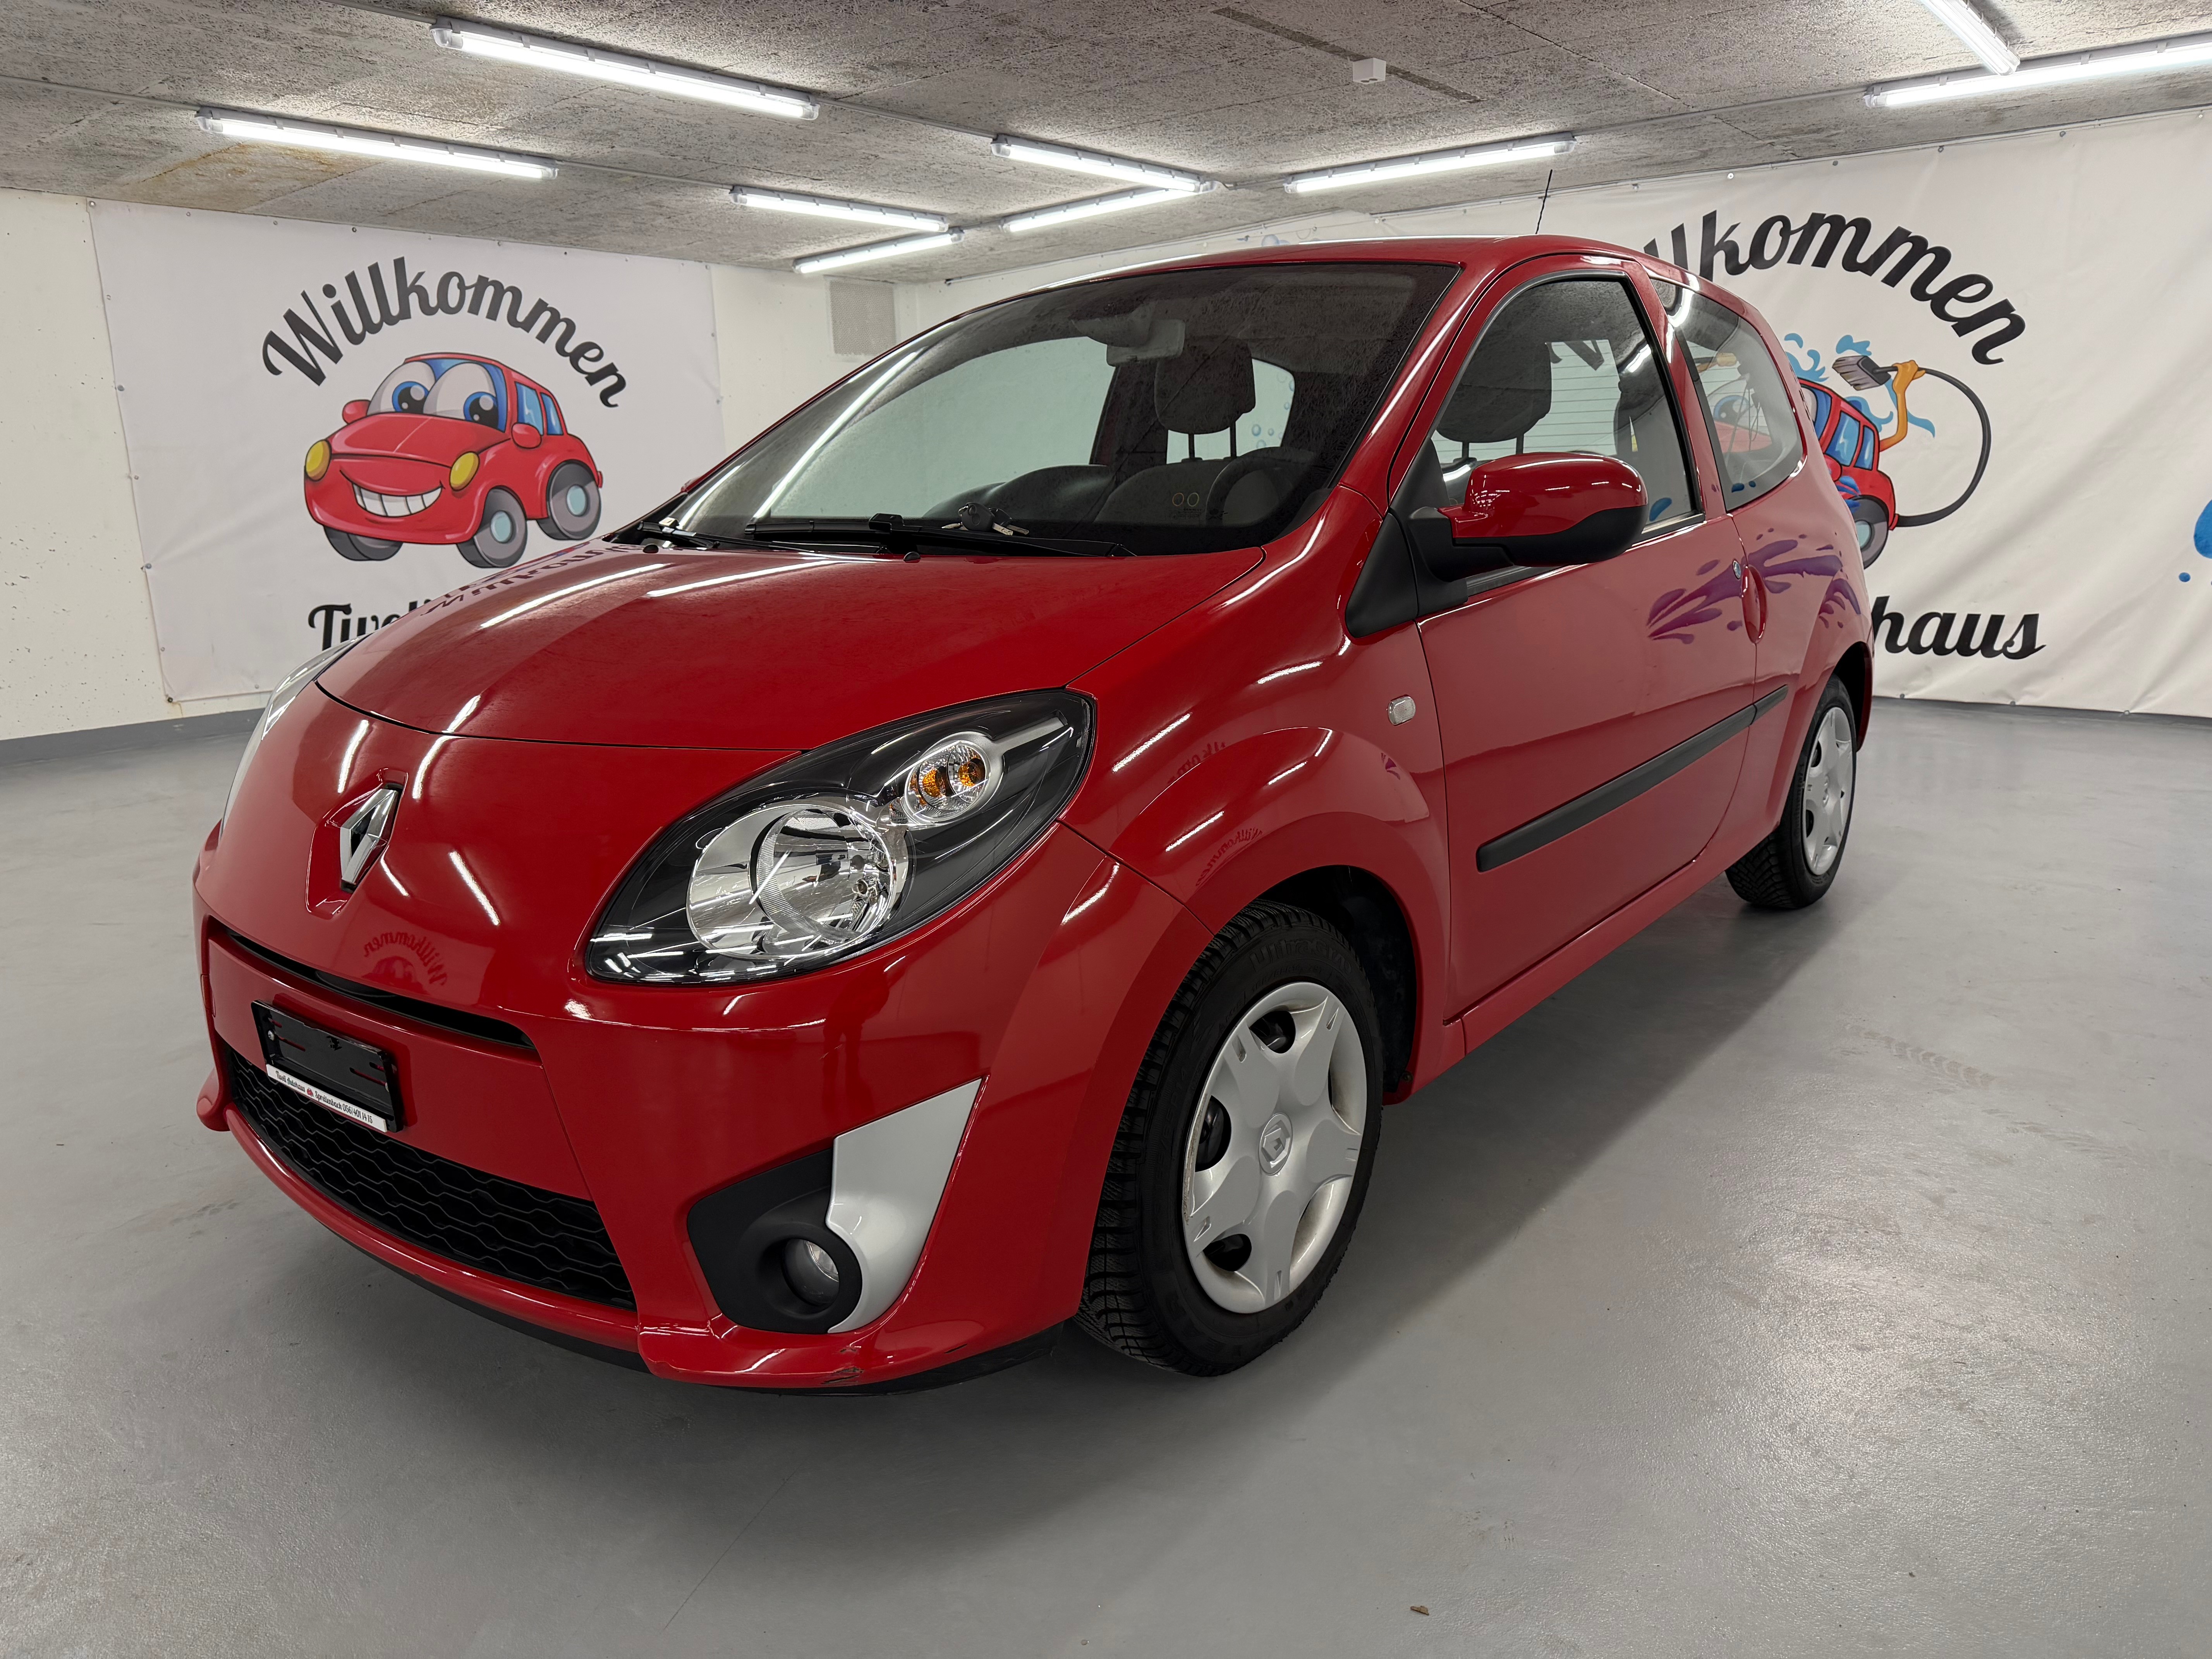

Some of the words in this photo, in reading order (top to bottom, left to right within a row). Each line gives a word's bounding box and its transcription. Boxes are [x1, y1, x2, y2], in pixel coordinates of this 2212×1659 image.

[263, 257, 626, 407] Willkommen
[1644, 210, 2025, 365] lkommen
[362, 1112, 367, 1121] 14
[368, 1115, 373, 1123] 15
